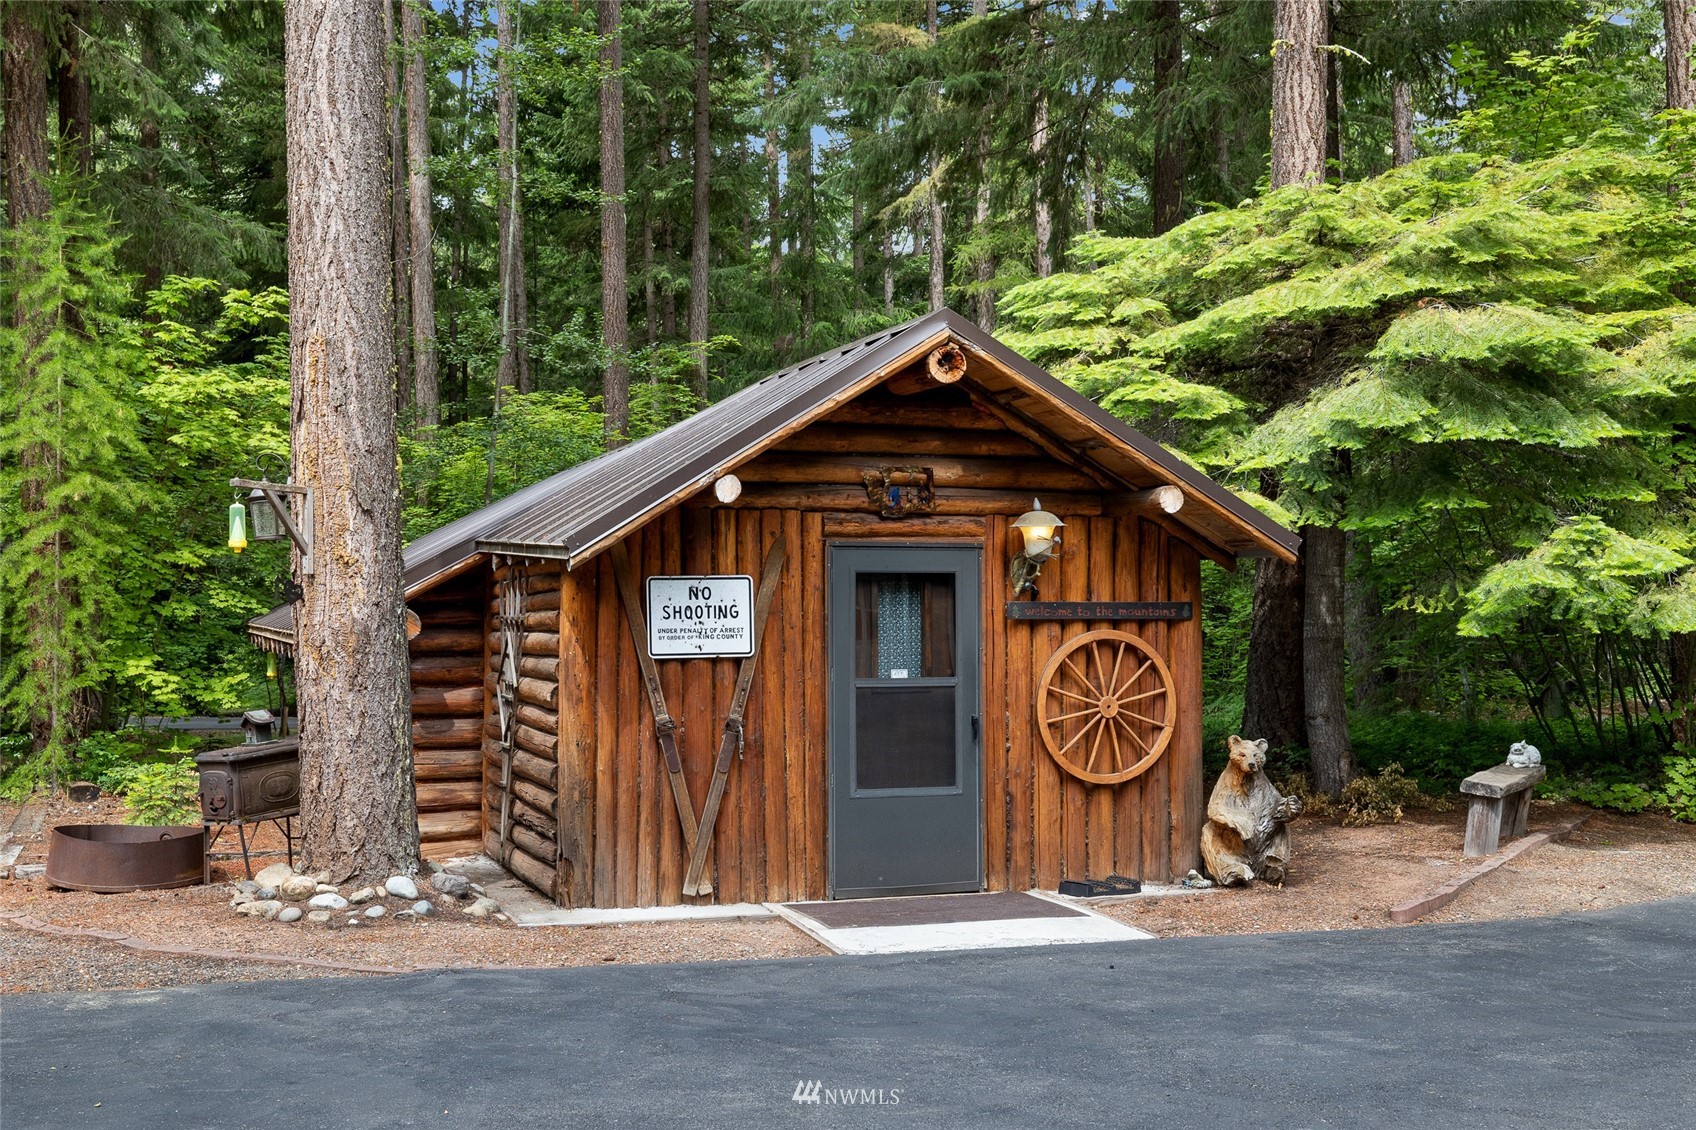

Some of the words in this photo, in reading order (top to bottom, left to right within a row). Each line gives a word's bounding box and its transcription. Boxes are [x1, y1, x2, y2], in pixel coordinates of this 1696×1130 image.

[688, 585, 712, 601] NO
[662, 604, 739, 620] SHOOTING
[1025, 606, 1073, 617] welcome
[1077, 606, 1090, 617] to
[1096, 606, 1113, 617] the
[1119, 606, 1177, 617] mountains
